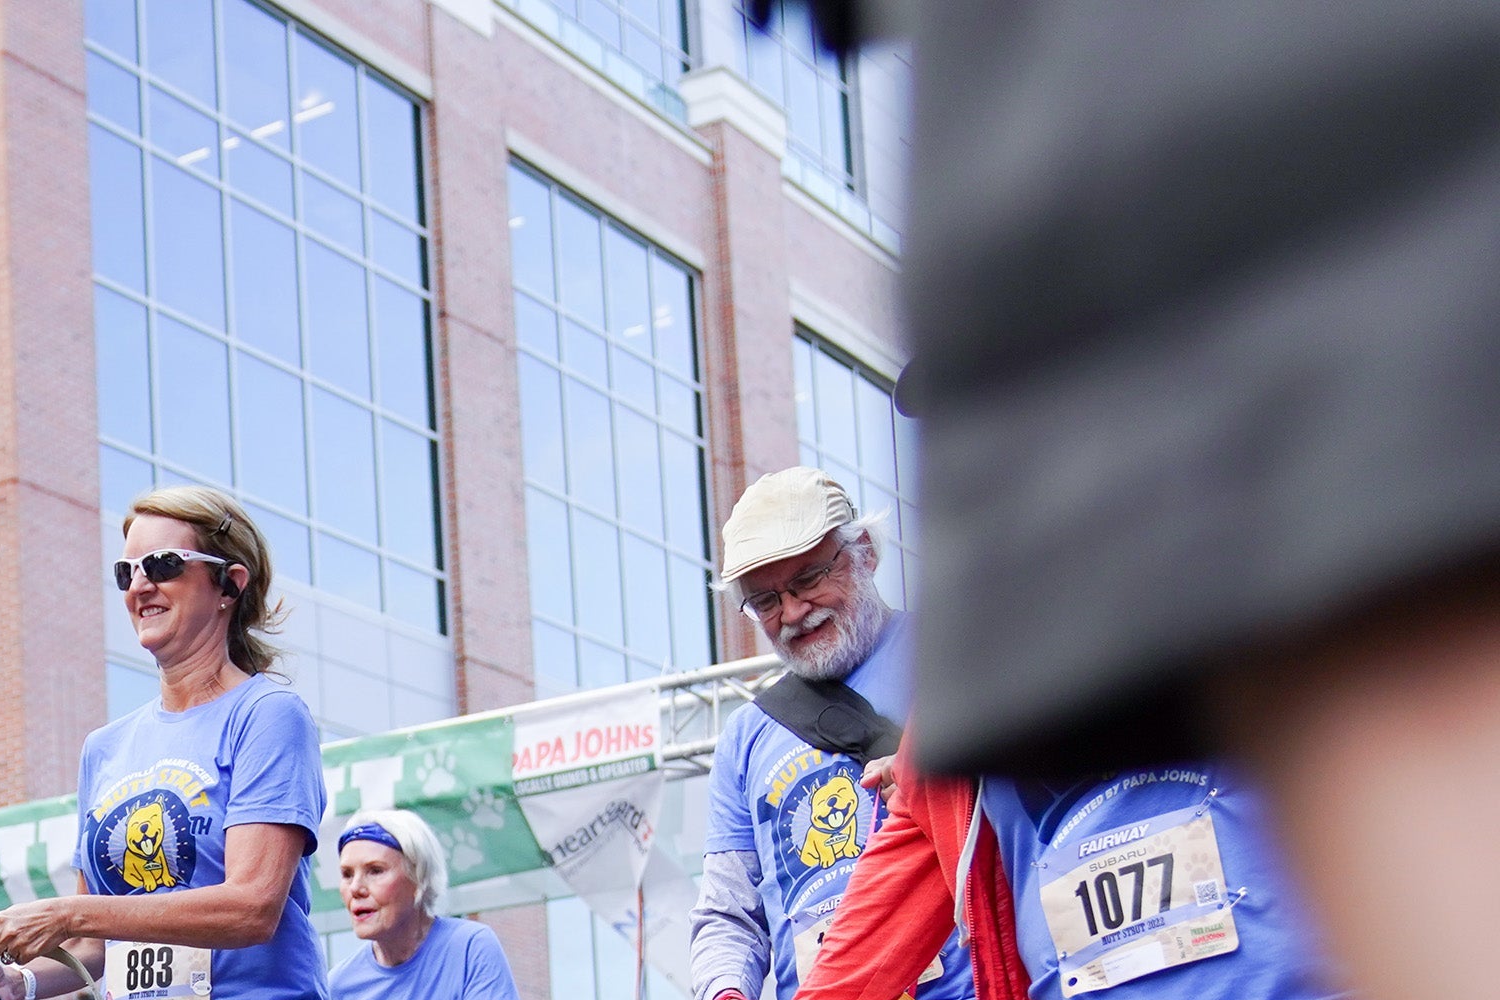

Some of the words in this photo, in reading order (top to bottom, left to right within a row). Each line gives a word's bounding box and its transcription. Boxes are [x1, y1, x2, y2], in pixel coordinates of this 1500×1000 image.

[572, 725, 654, 761] JOHNS
[158, 768, 210, 808] STRUT
[765, 749, 822, 808] MUTT
[1052, 796, 1104, 849] PRESENTED
[1105, 783, 1122, 798] BY
[1123, 772, 1157, 790] PAPA
[1160, 770, 1208, 786] JOHNS
[1079, 824, 1150, 859] FAIRWAY
[1089, 848, 1147, 872] SUBARU
[824, 869, 838, 882] BY
[1075, 853, 1174, 937] 1077
[1102, 931, 1121, 946] MUTT
[127, 946, 173, 991] 883
